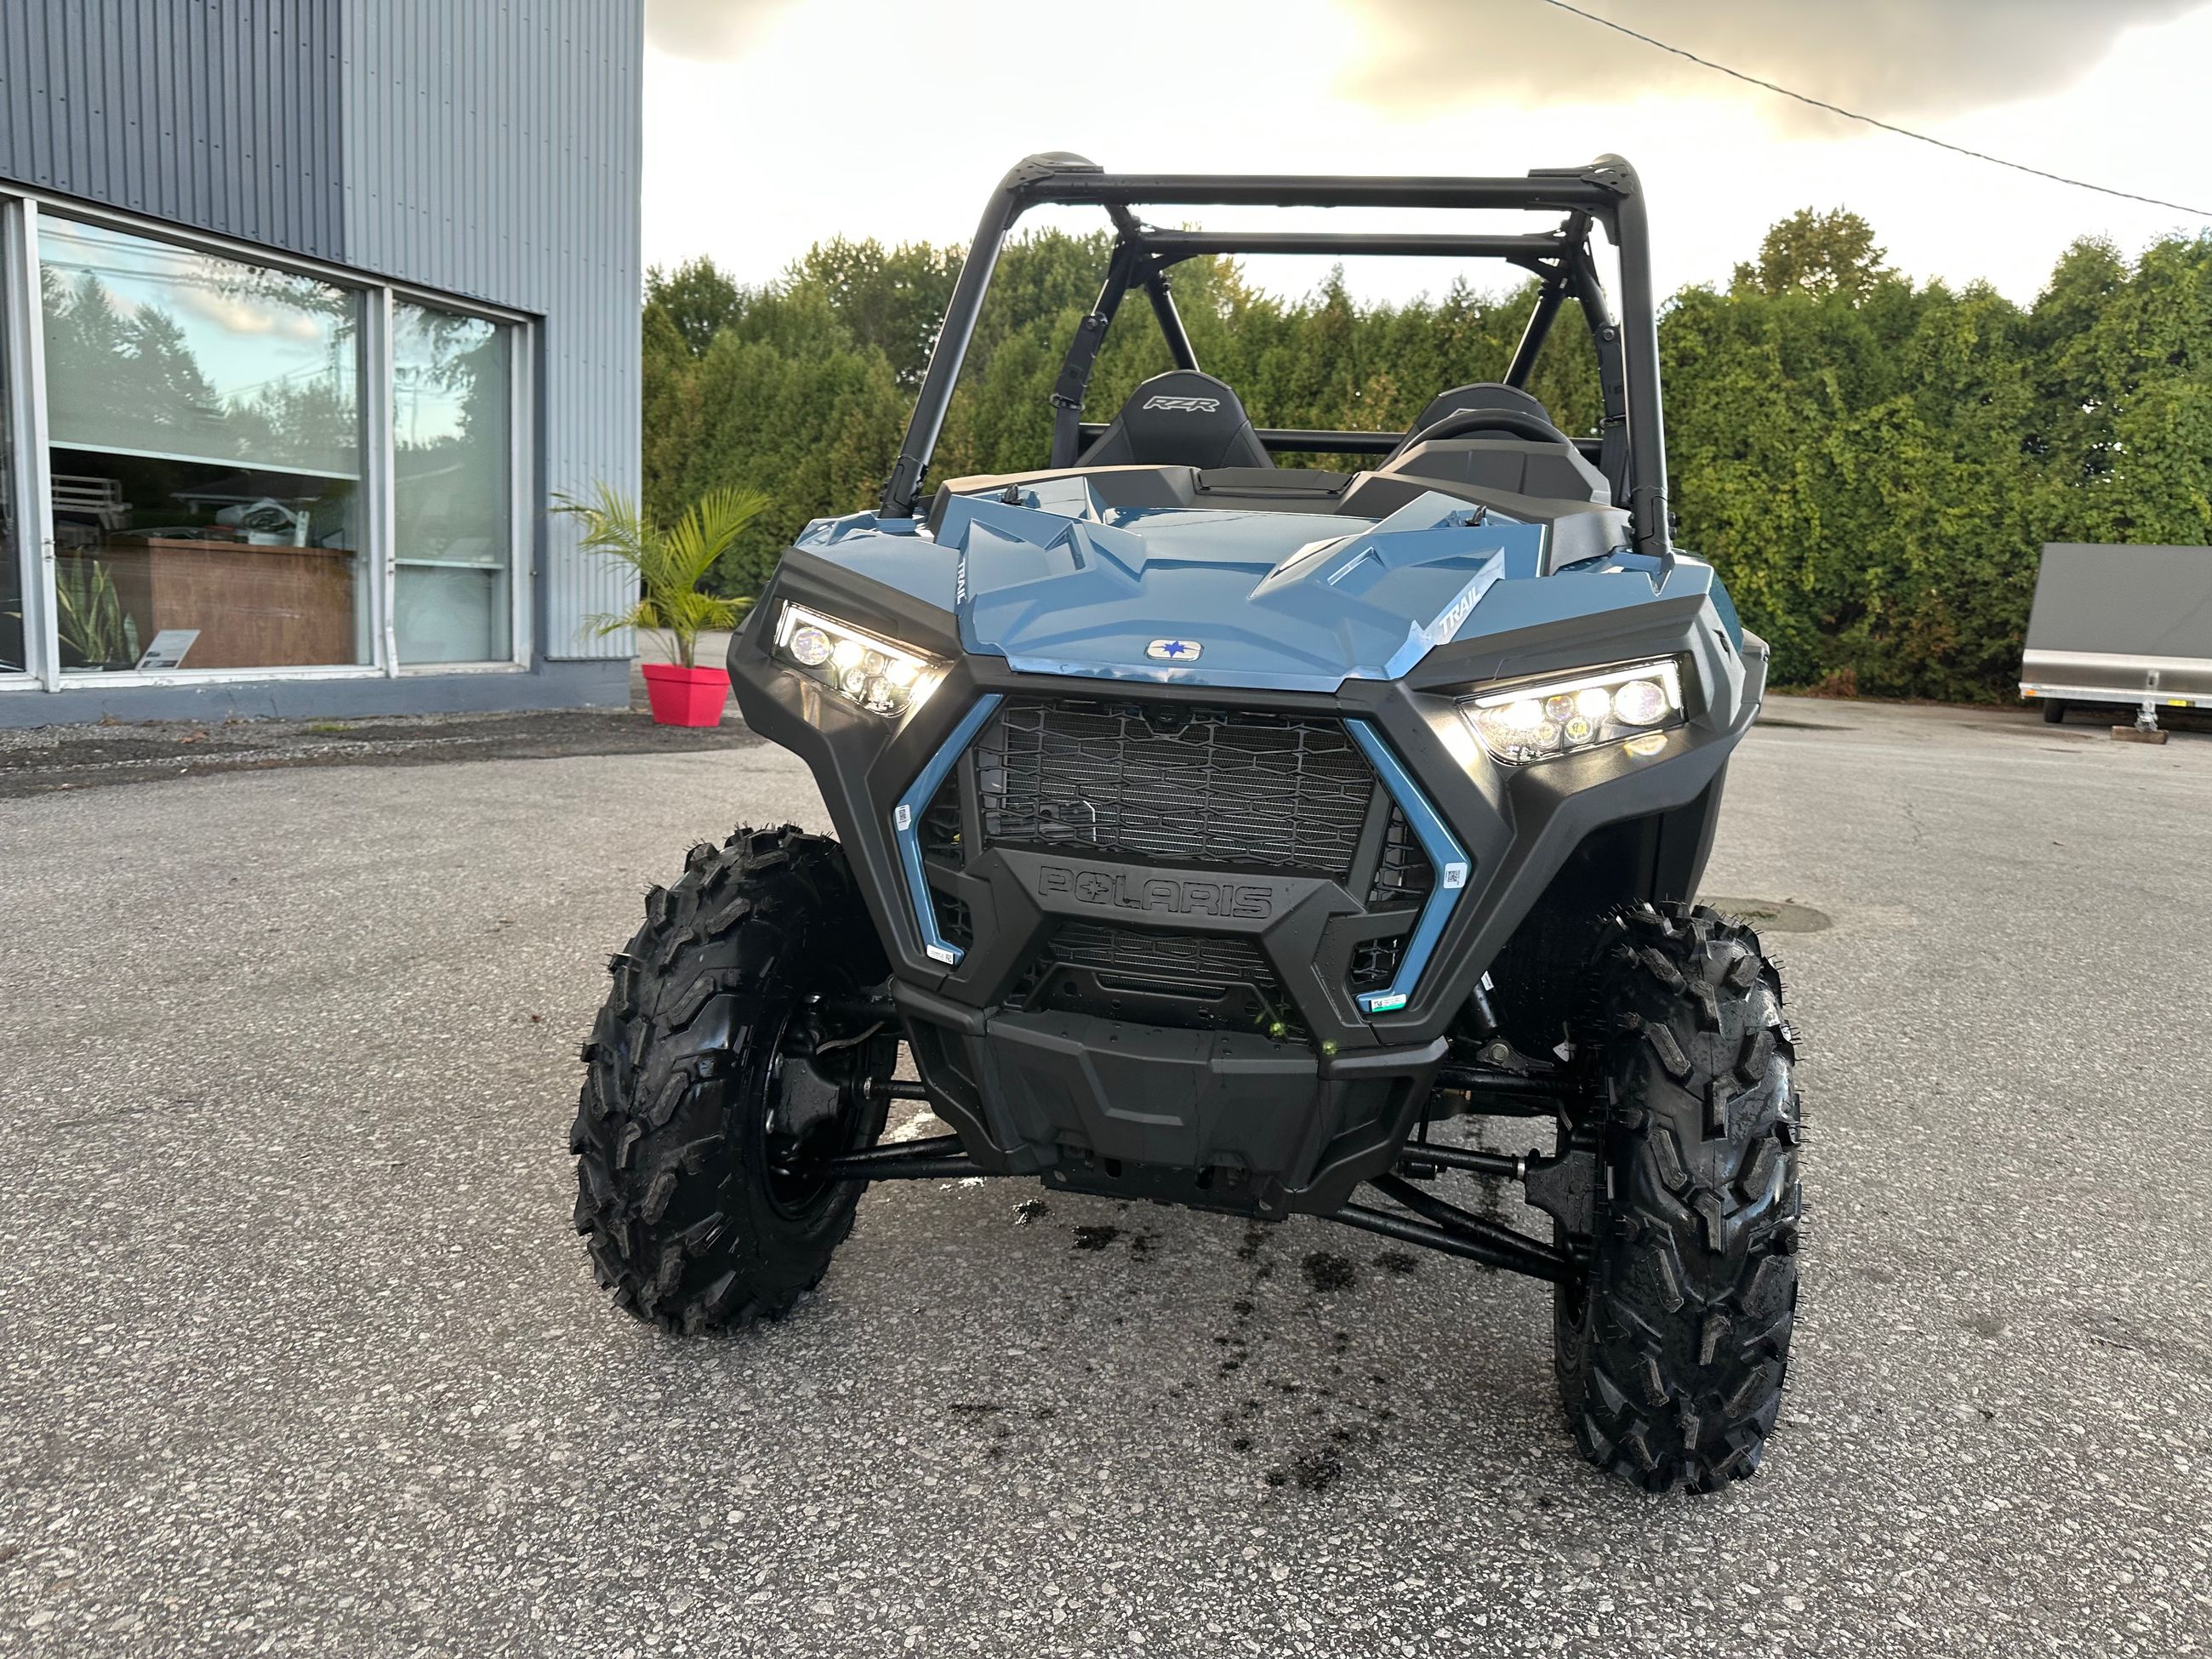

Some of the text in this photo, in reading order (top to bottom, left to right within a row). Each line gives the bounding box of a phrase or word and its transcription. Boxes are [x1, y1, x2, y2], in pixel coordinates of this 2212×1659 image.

[1143, 396, 1221, 413] RZR
[956, 557, 967, 605] TRAIL
[1439, 585, 1482, 636] TRAIL
[1038, 866, 1273, 920] POLARIS
